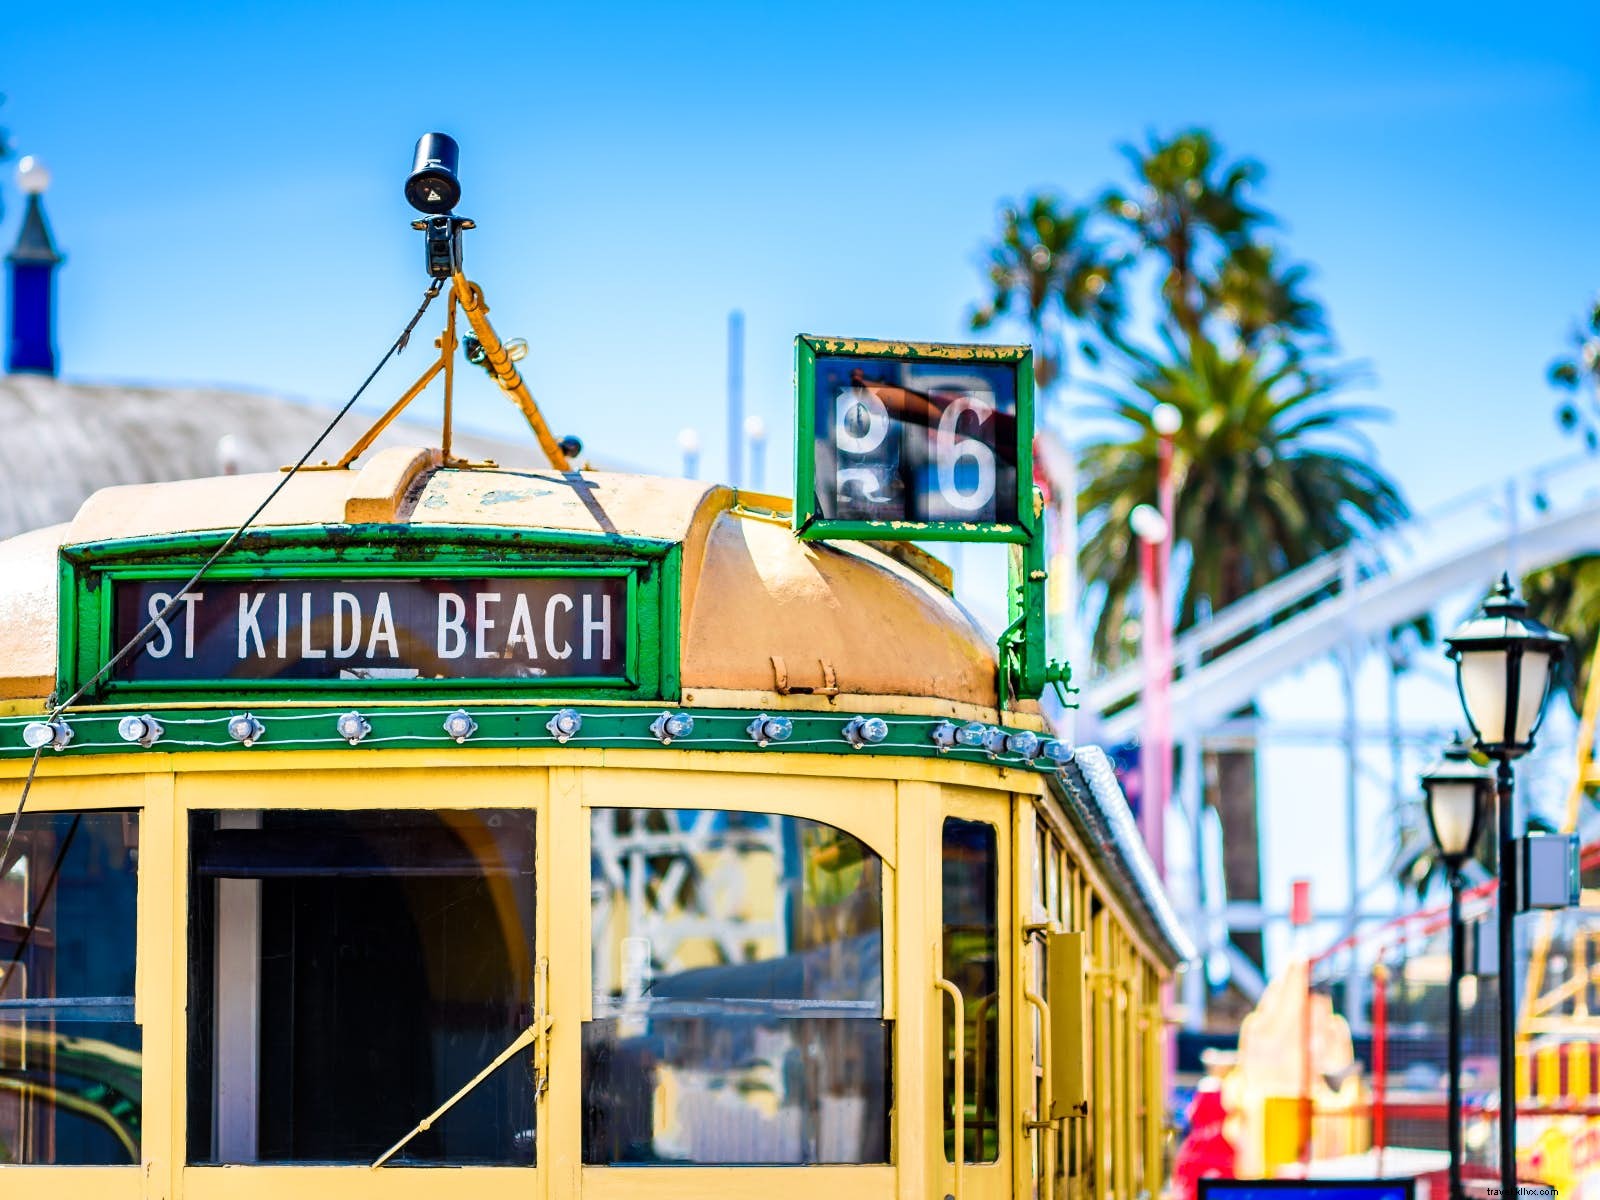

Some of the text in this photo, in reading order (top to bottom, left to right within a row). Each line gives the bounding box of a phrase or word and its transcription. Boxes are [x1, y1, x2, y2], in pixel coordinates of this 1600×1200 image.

[145, 592, 612, 660] ST KILDA BEACH
